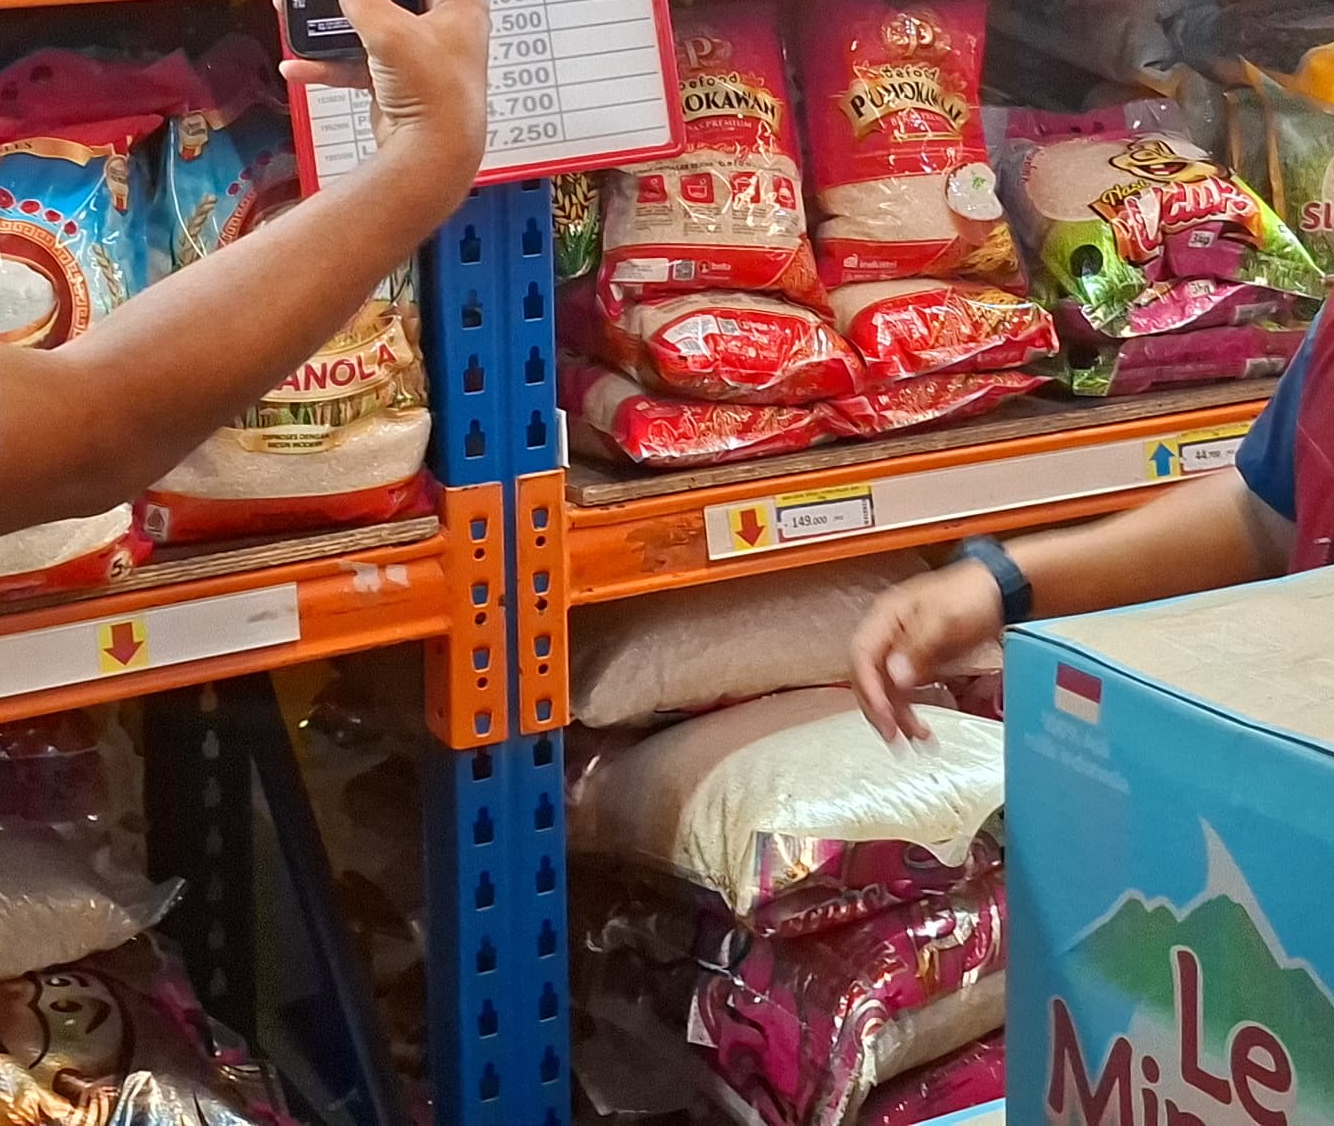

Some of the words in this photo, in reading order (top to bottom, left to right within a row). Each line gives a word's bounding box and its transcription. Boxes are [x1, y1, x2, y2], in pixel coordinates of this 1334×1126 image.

[490, 10, 542, 34] .500
[488, 66, 551, 90] .500
[683, 91, 776, 120] OKAWAN
[792, 514, 828, 529] 149.000
[1174, 948, 1294, 1126] Le
